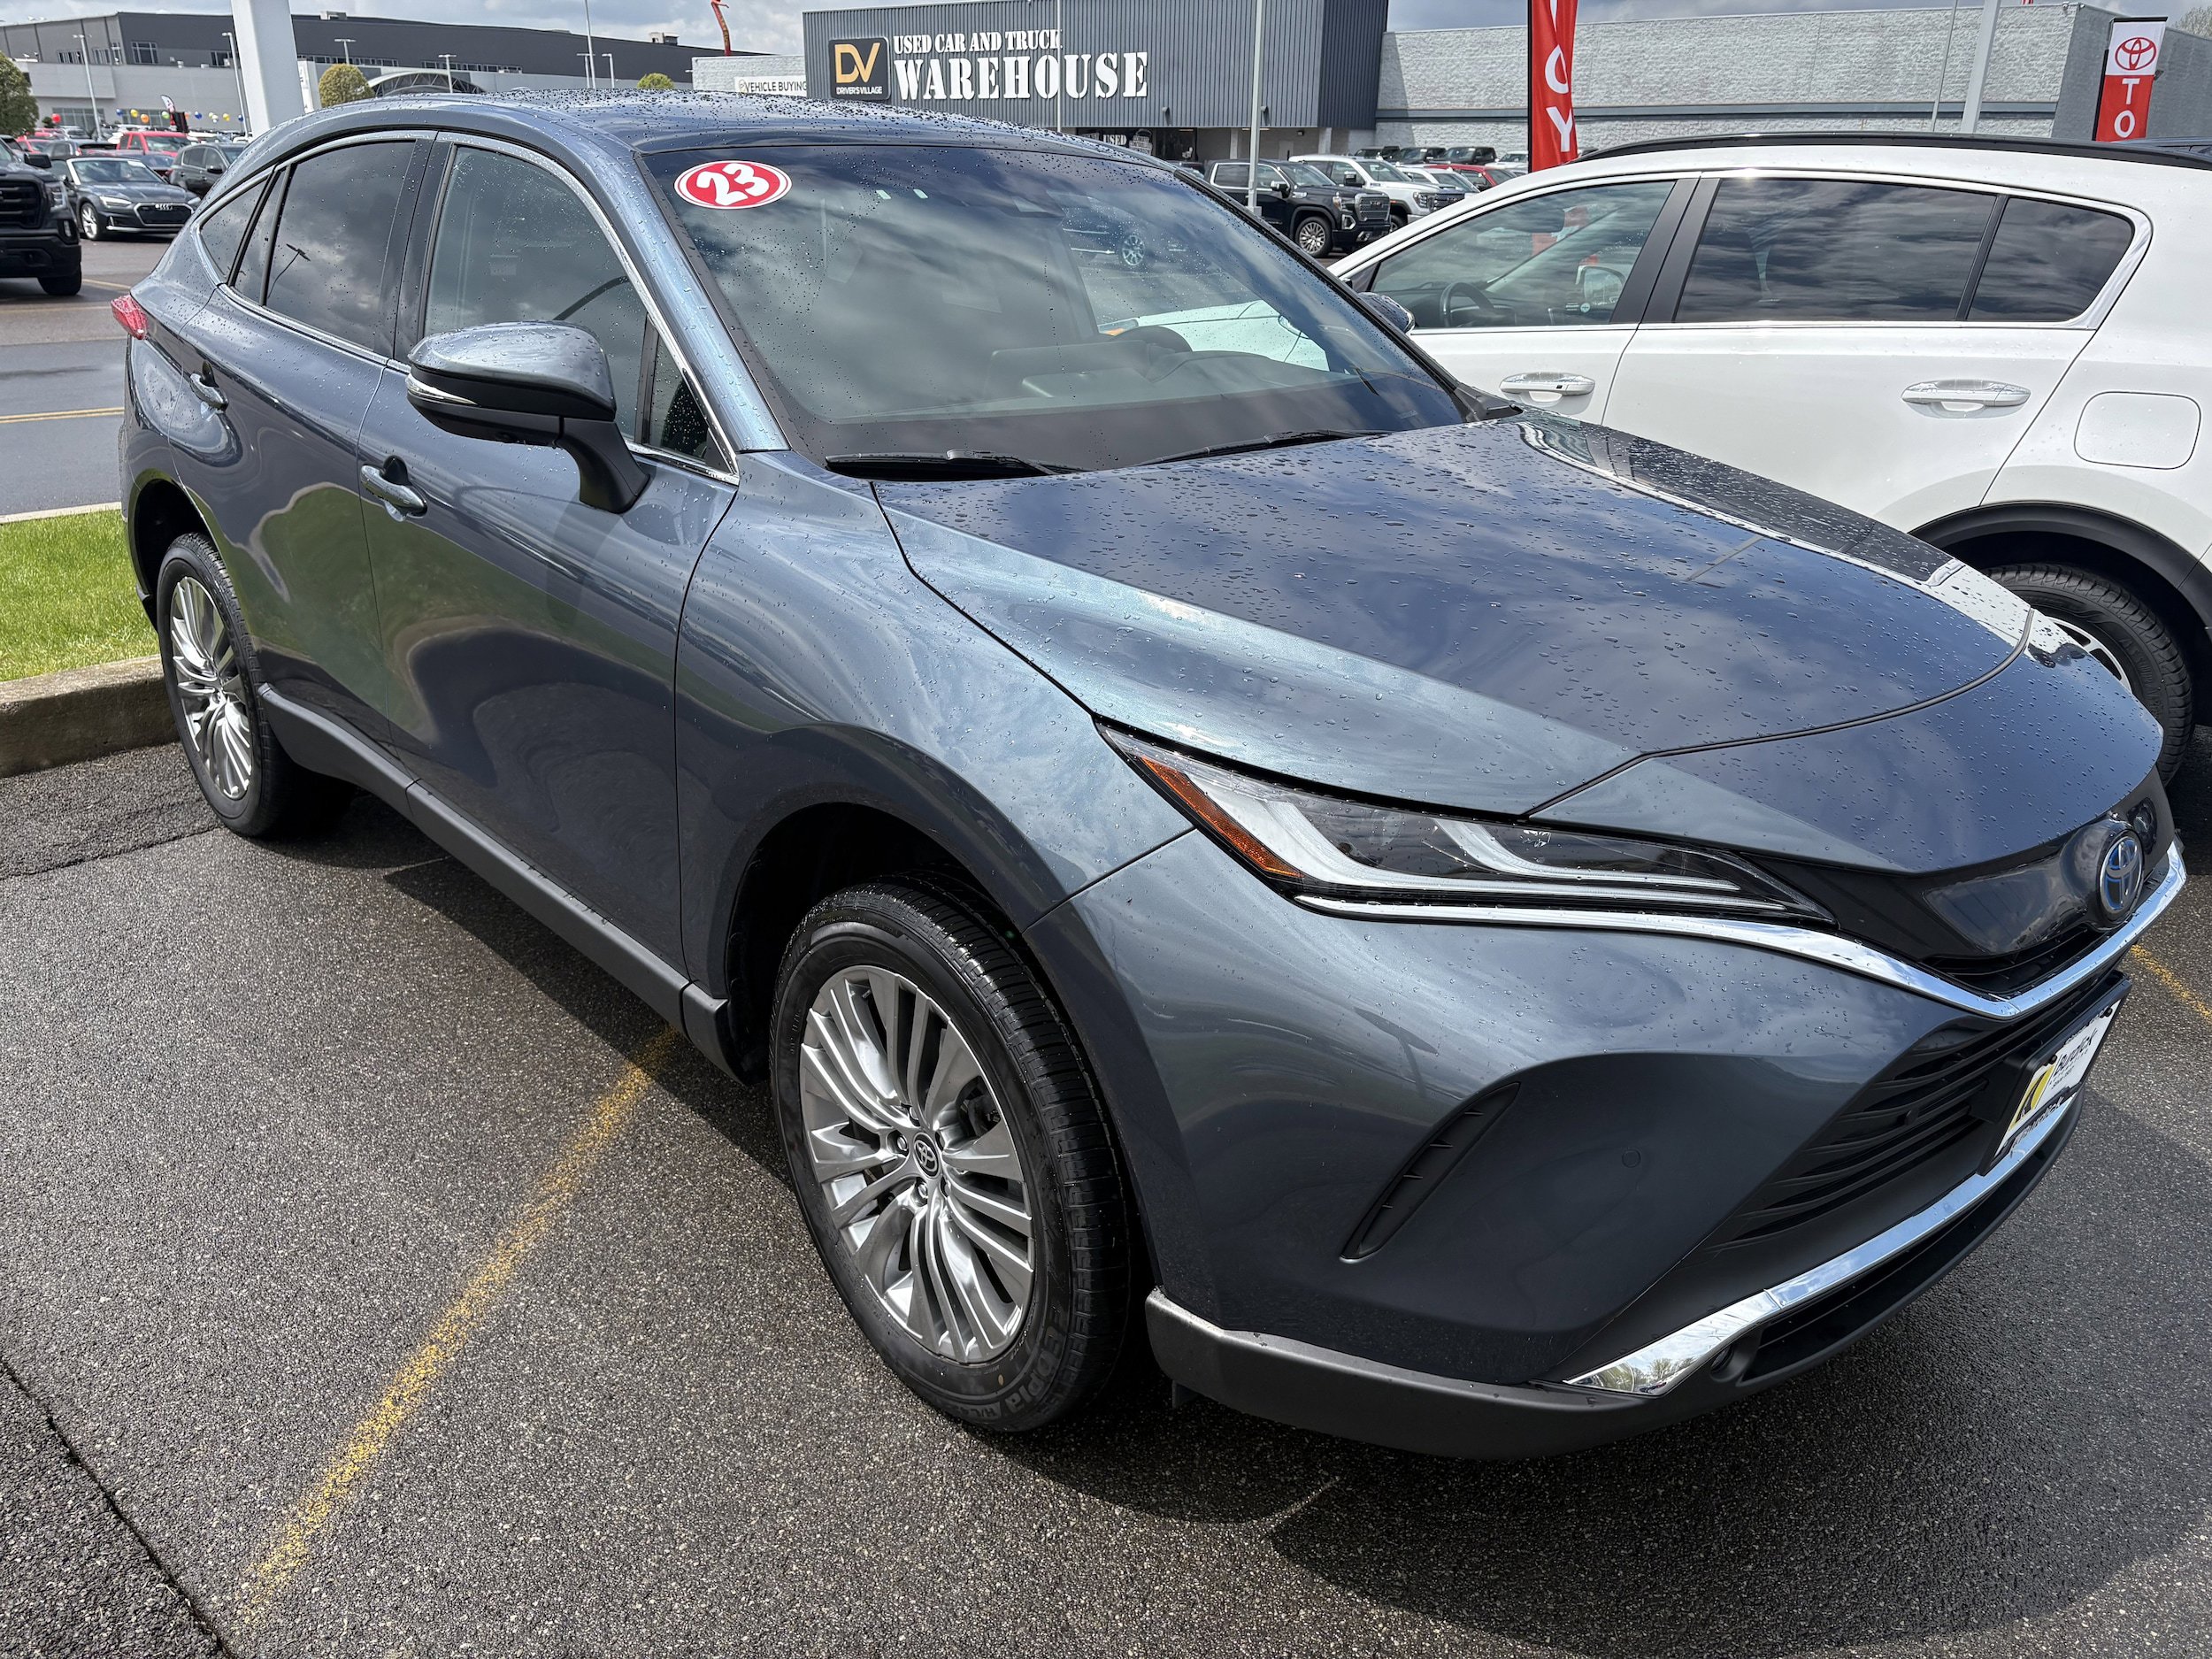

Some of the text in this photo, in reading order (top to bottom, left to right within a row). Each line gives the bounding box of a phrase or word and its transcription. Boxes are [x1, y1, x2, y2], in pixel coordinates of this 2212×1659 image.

[894, 29, 1064, 55] USED CAR AND TRUCK
[834, 42, 880, 84] DV
[745, 81, 777, 93] VEHICLE
[894, 52, 1148, 101] WAREHOUSE
[860, 86, 883, 95] VILLAGE
[1102, 134, 1127, 145] USED
[695, 163, 770, 206] 23
